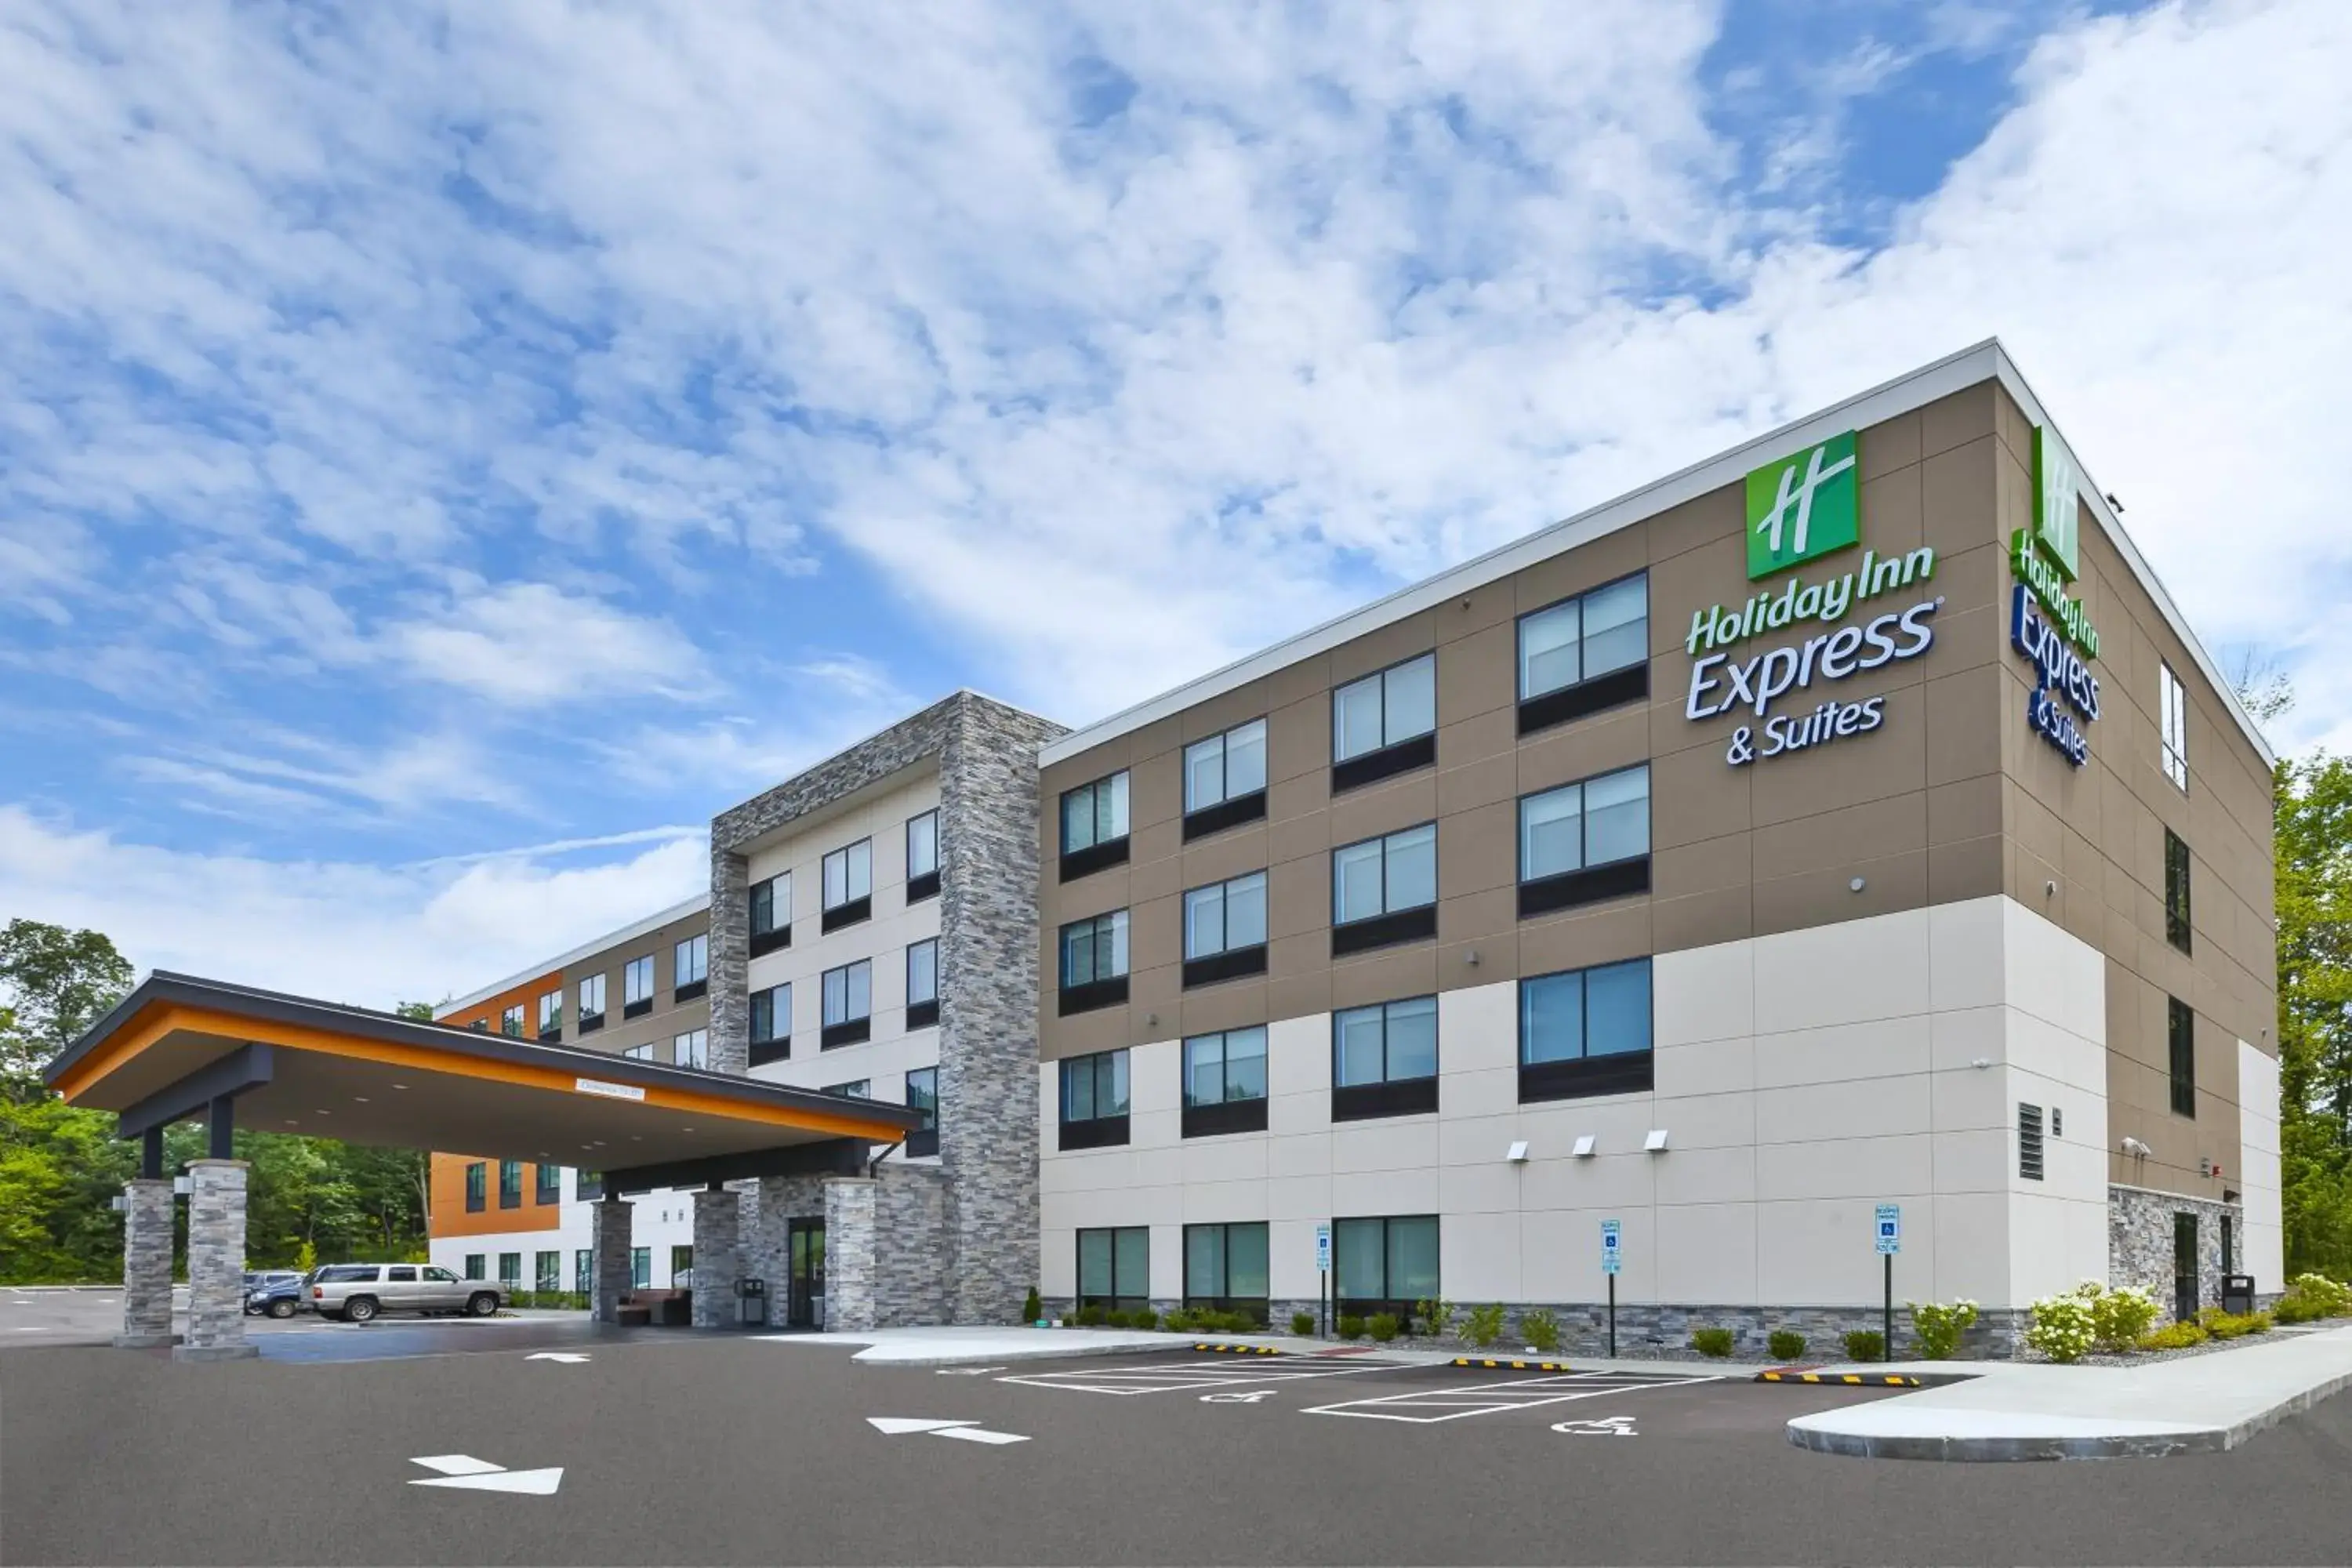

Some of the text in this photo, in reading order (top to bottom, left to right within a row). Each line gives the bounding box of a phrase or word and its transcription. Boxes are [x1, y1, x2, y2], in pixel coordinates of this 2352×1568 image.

[1756, 446, 1856, 554] H
[1686, 547, 1936, 655] Holiday Inn
[2012, 528, 2100, 660] Holiday Inn
[1686, 601, 1938, 721] Express
[2013, 583, 2100, 723] Express
[1726, 697, 1885, 766] & Suites
[2047, 702, 2089, 768] Suites
